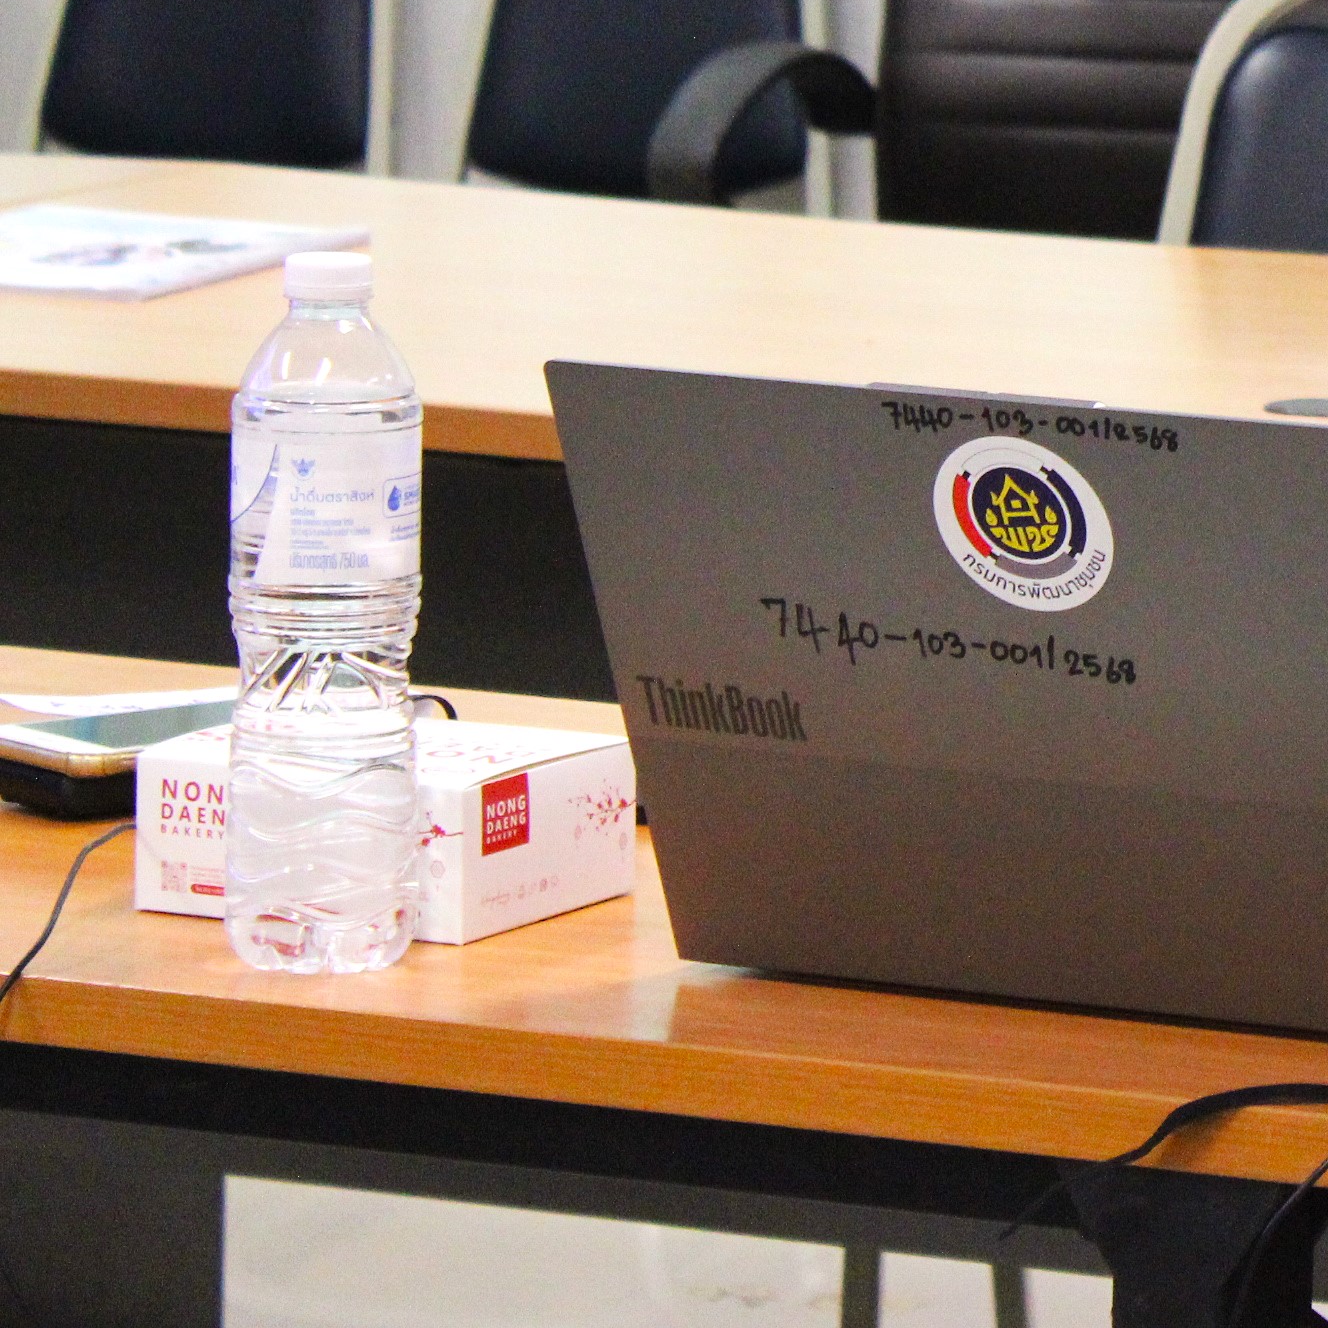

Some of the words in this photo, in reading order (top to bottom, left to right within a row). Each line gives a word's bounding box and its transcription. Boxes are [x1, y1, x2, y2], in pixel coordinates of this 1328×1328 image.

[962, 549, 1106, 600] กรมการพัฒนาชุมชน
[637, 674, 807, 742] ThinkBook
[162, 778, 225, 806] NON
[161, 803, 226, 826] DAEN
[486, 794, 527, 820] NONG
[161, 823, 225, 840] BAKERY
[486, 812, 527, 835] DAENG
[486, 829, 518, 845] BAKERY
